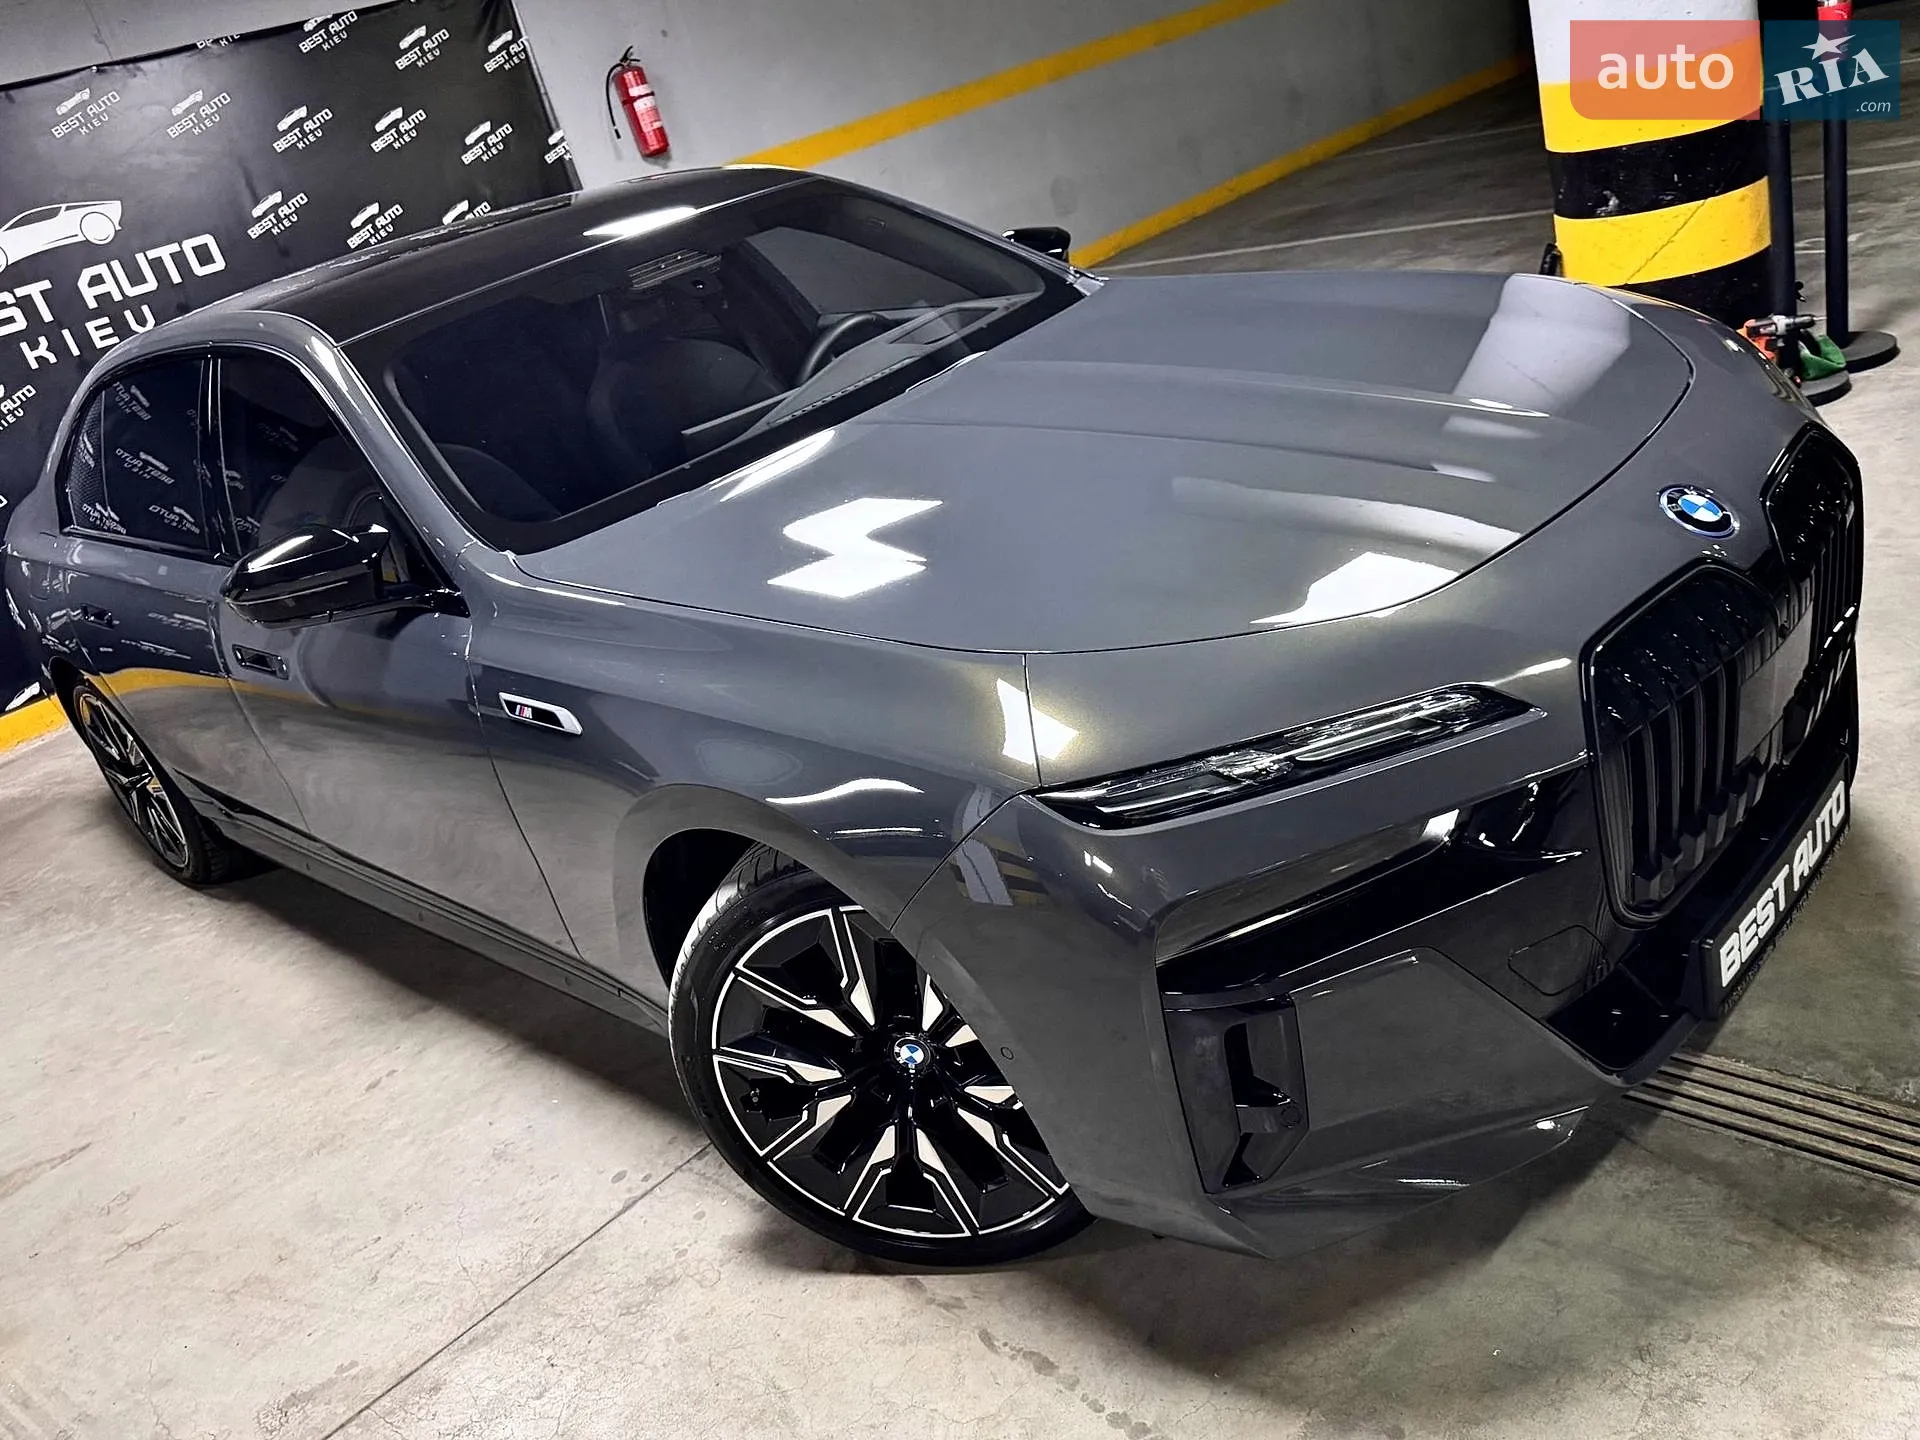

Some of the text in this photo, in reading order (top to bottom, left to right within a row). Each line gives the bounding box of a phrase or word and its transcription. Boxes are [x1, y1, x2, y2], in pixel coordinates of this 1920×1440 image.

[298, 10, 358, 54] BEST AUTO
[321, 30, 349, 52] KIEV
[395, 28, 450, 71] BEST AUTO
[416, 49, 442, 68] KIEV
[483, 50, 509, 73] BEST
[503, 51, 525, 70] KIEV
[51, 90, 121, 139] BEST AUTO
[79, 113, 109, 136] KIEV
[166, 92, 231, 139] BEST AUTO
[192, 114, 221, 136] KIEV
[272, 108, 333, 153] BEST AUTO
[296, 129, 323, 150] KIEV
[370, 109, 427, 153] BEST AUTO
[392, 129, 418, 150] KIEV
[461, 123, 513, 165] BEST AUTO
[480, 142, 504, 162] KIEV
[544, 141, 570, 164] BEST
[247, 192, 309, 240] BEST AUTO
[271, 213, 298, 236] KIEV
[346, 204, 404, 249] BEST AUTO
[369, 224, 394, 245] KIEV
[77, 233, 226, 310] AUTO
[20, 304, 156, 369] KIEV
[1, 384, 37, 414] AUTO
[0, 407, 24, 430] IEV
[1720, 780, 1845, 987] BEST AUTO
